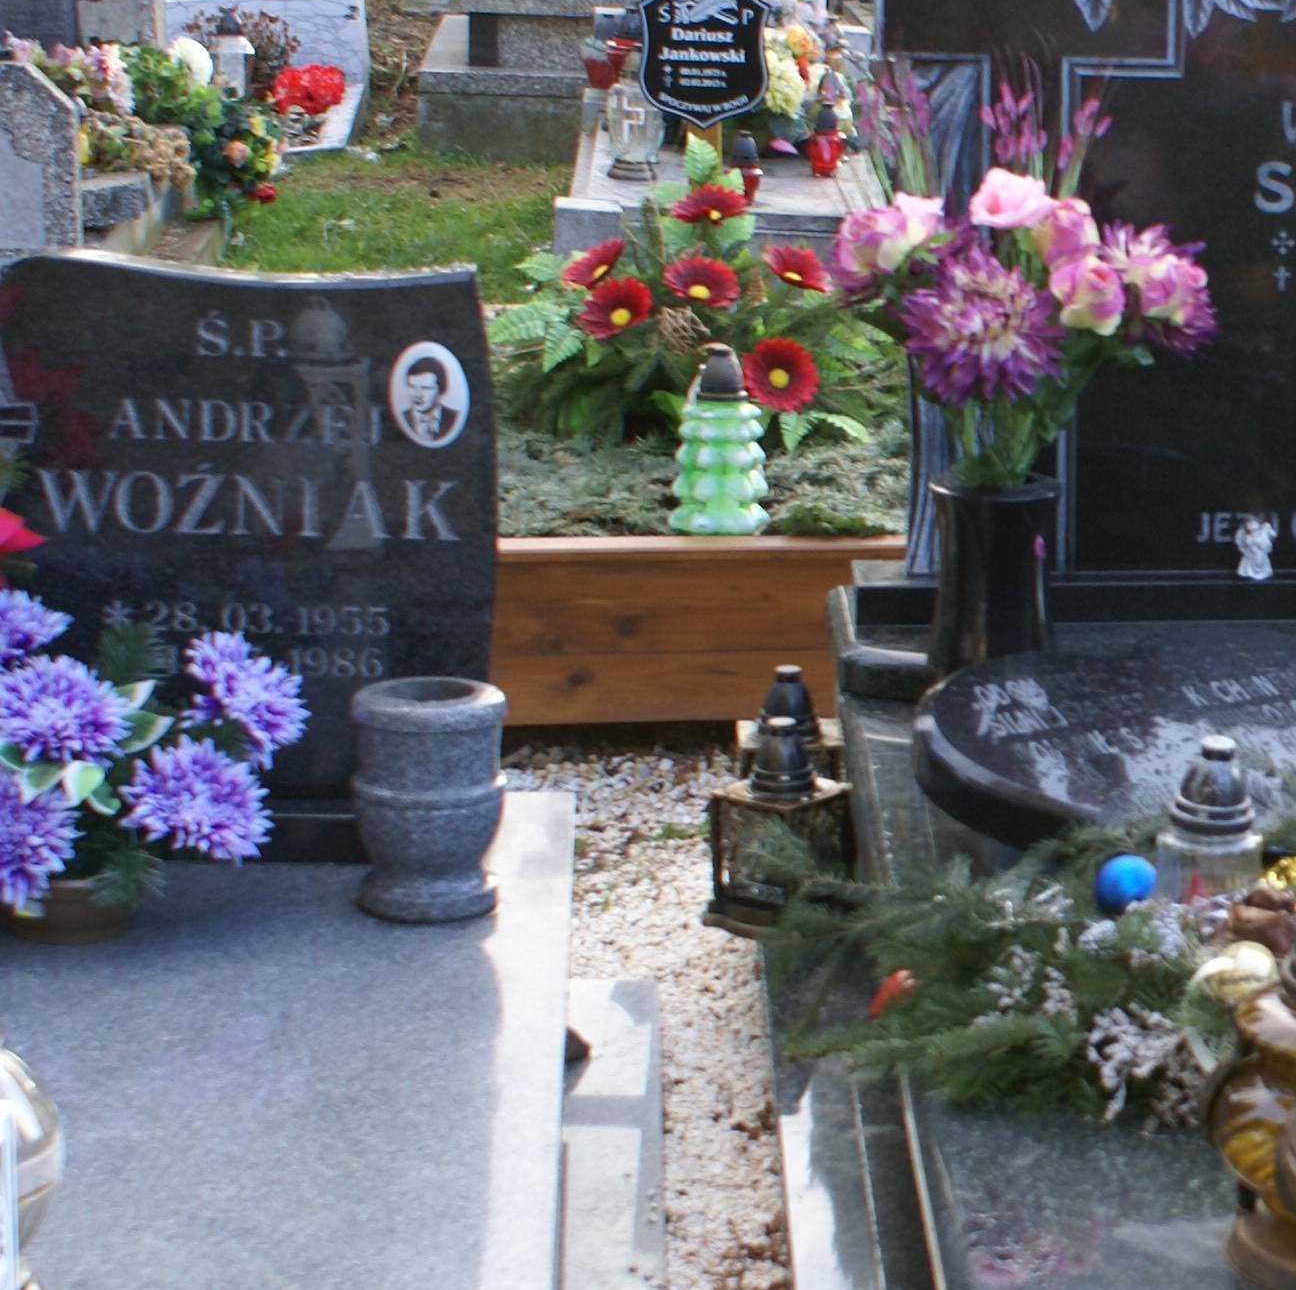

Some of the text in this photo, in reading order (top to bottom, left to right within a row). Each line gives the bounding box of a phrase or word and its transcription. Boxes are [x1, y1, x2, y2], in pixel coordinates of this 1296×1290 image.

[658, 46, 746, 64] Jankowski
[671, 27, 735, 44] Dariusz
[196, 312, 289, 359] Ś.P.
[107, 398, 384, 447] ANDRZEJ
[37, 463, 461, 542] WOŹNIAK
